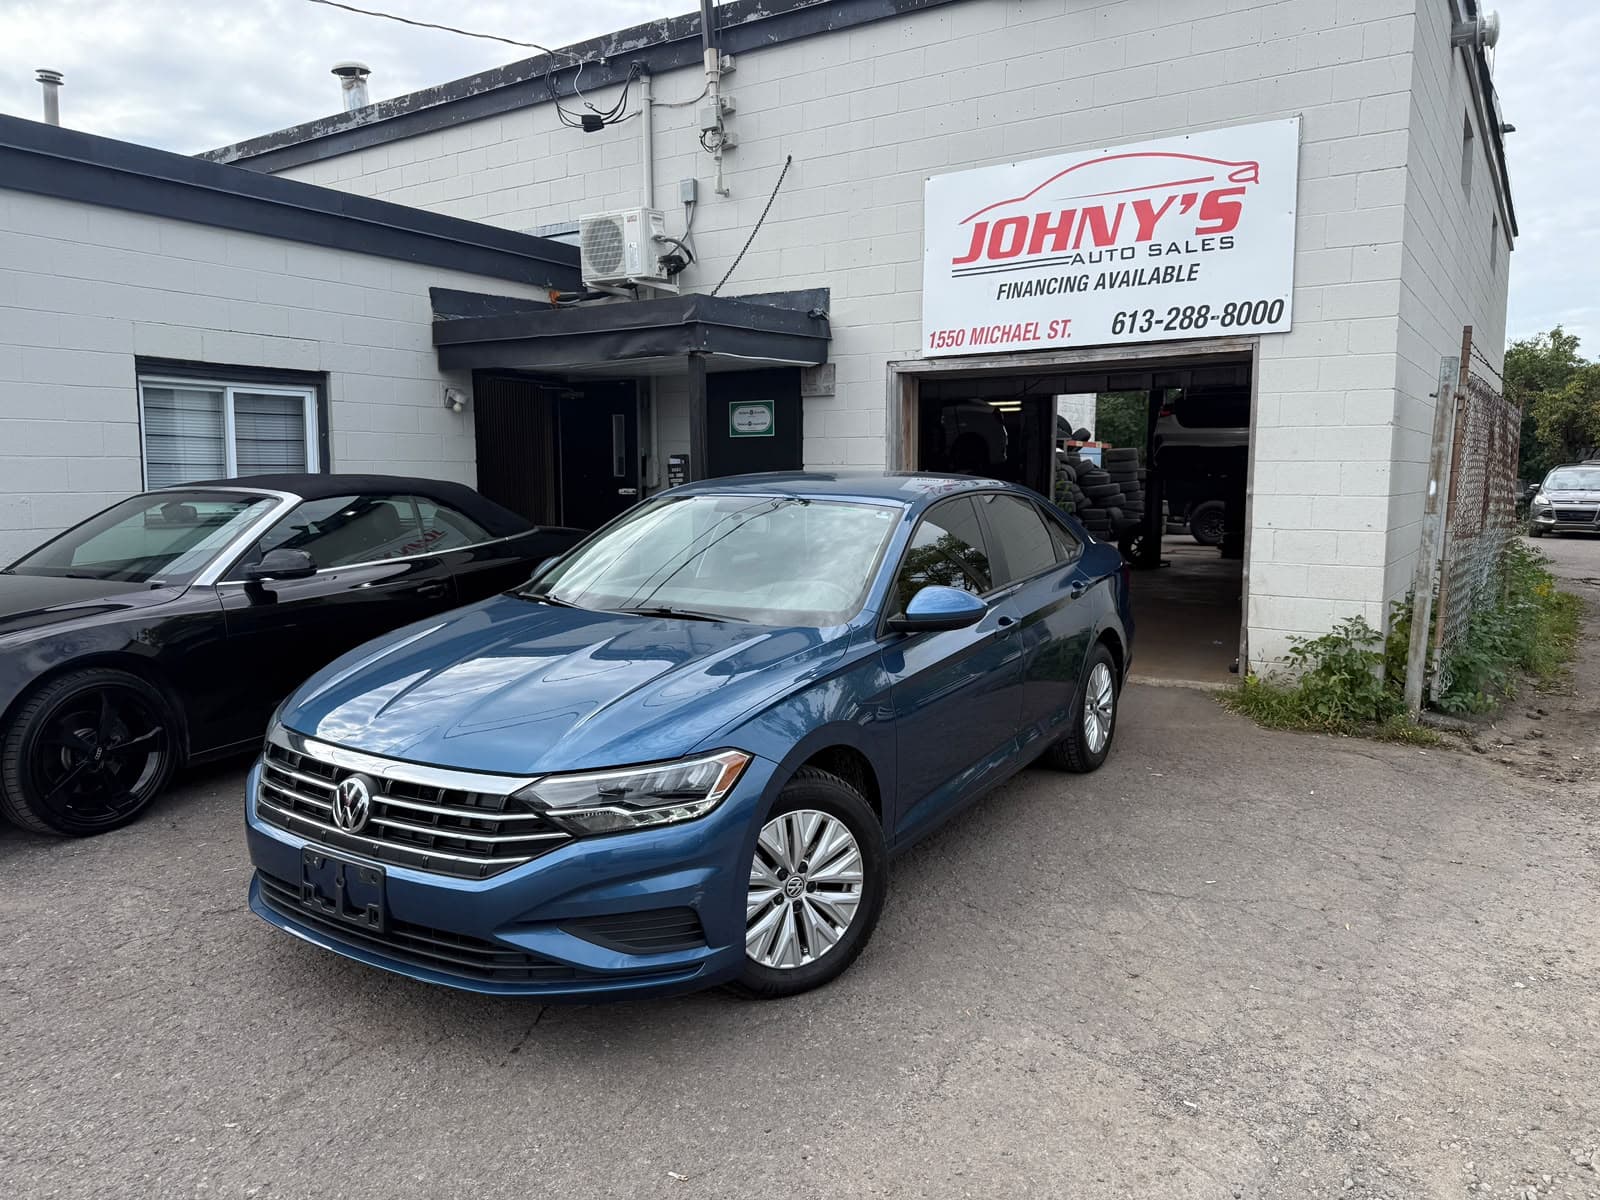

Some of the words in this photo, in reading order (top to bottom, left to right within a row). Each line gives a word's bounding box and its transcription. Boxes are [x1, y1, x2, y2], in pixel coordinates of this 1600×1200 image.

[952, 186, 1246, 265] JOHNY'S
[1070, 246, 1135, 266] AUTO
[1148, 235, 1235, 257] SALES
[996, 273, 1090, 301] FINANCING
[1093, 262, 1201, 291] AVAILABLE
[928, 328, 966, 349] 1550
[968, 321, 1042, 346] MICHAEL
[1047, 318, 1072, 340] ST.
[1111, 298, 1285, 335] 613-288-8000
